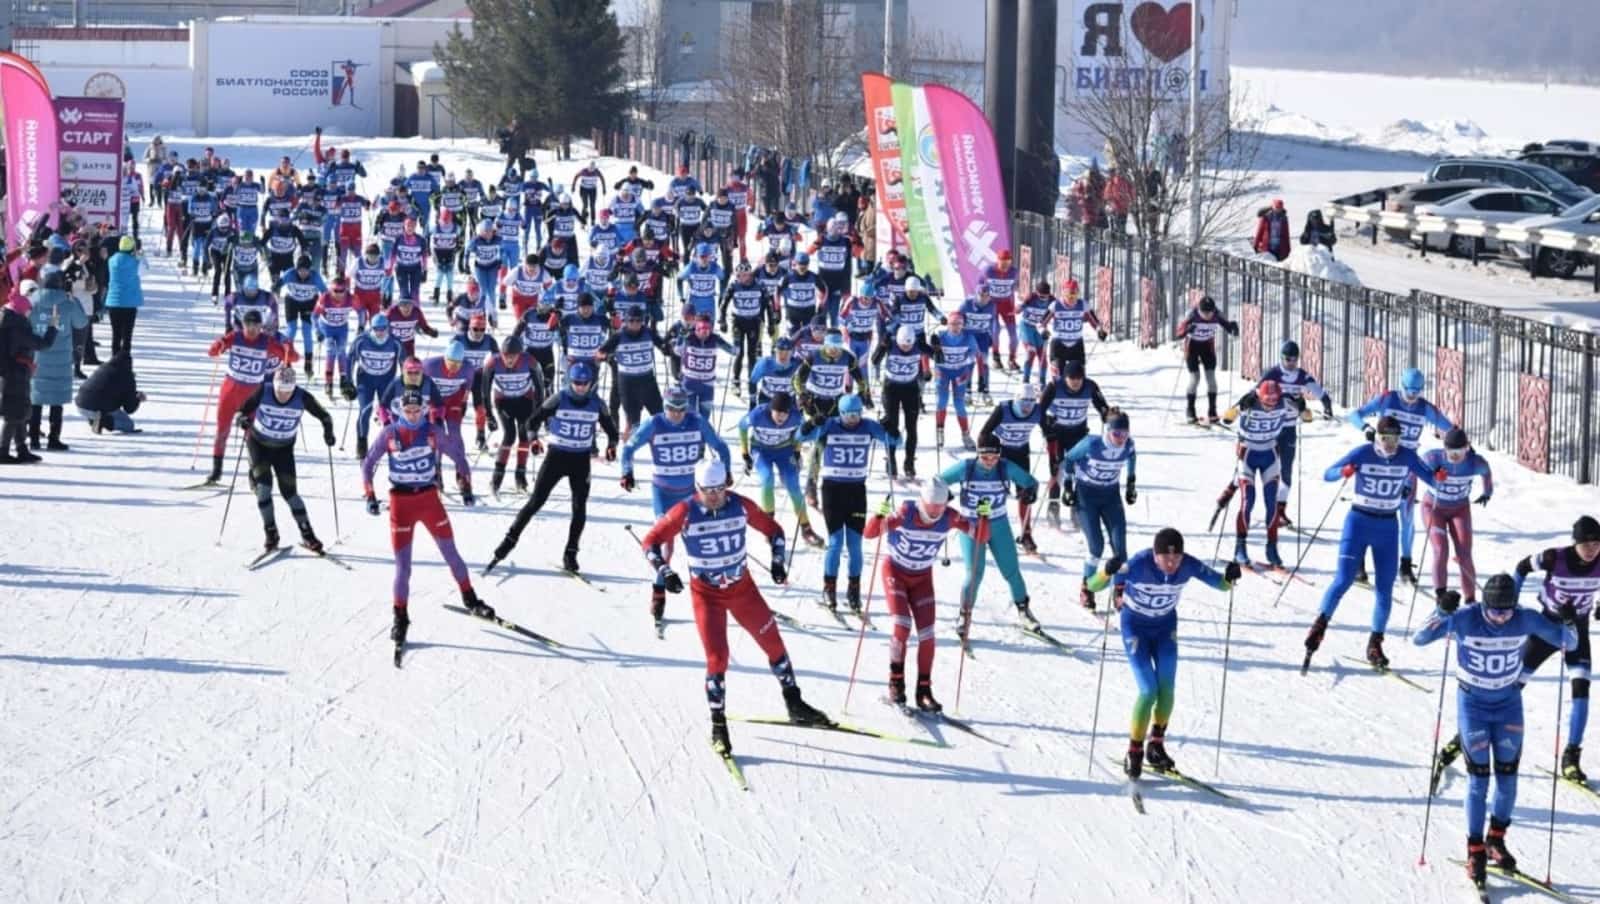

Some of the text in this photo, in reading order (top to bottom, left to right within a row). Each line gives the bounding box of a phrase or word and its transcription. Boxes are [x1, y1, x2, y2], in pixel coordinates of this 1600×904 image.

[1080, 2, 1124, 57] Я
[290, 69, 329, 78] СОЮЗ
[216, 78, 329, 87] БИАТЛОНИСТОВ
[273, 87, 329, 96] РОССИИ
[62, 130, 113, 145] СТАРТ
[571, 334, 601, 346] 380
[231, 355, 262, 374] 320
[622, 351, 652, 365] 353
[687, 355, 714, 370] 658
[815, 374, 843, 386] 321
[263, 415, 298, 430] 379
[559, 421, 592, 437] 318
[657, 444, 699, 463] 388
[832, 447, 866, 464] 312
[1362, 476, 1403, 496] 307
[700, 533, 742, 555] 311
[897, 535, 938, 558] 324
[1554, 590, 1594, 607] 673
[1467, 649, 1522, 674] 305
